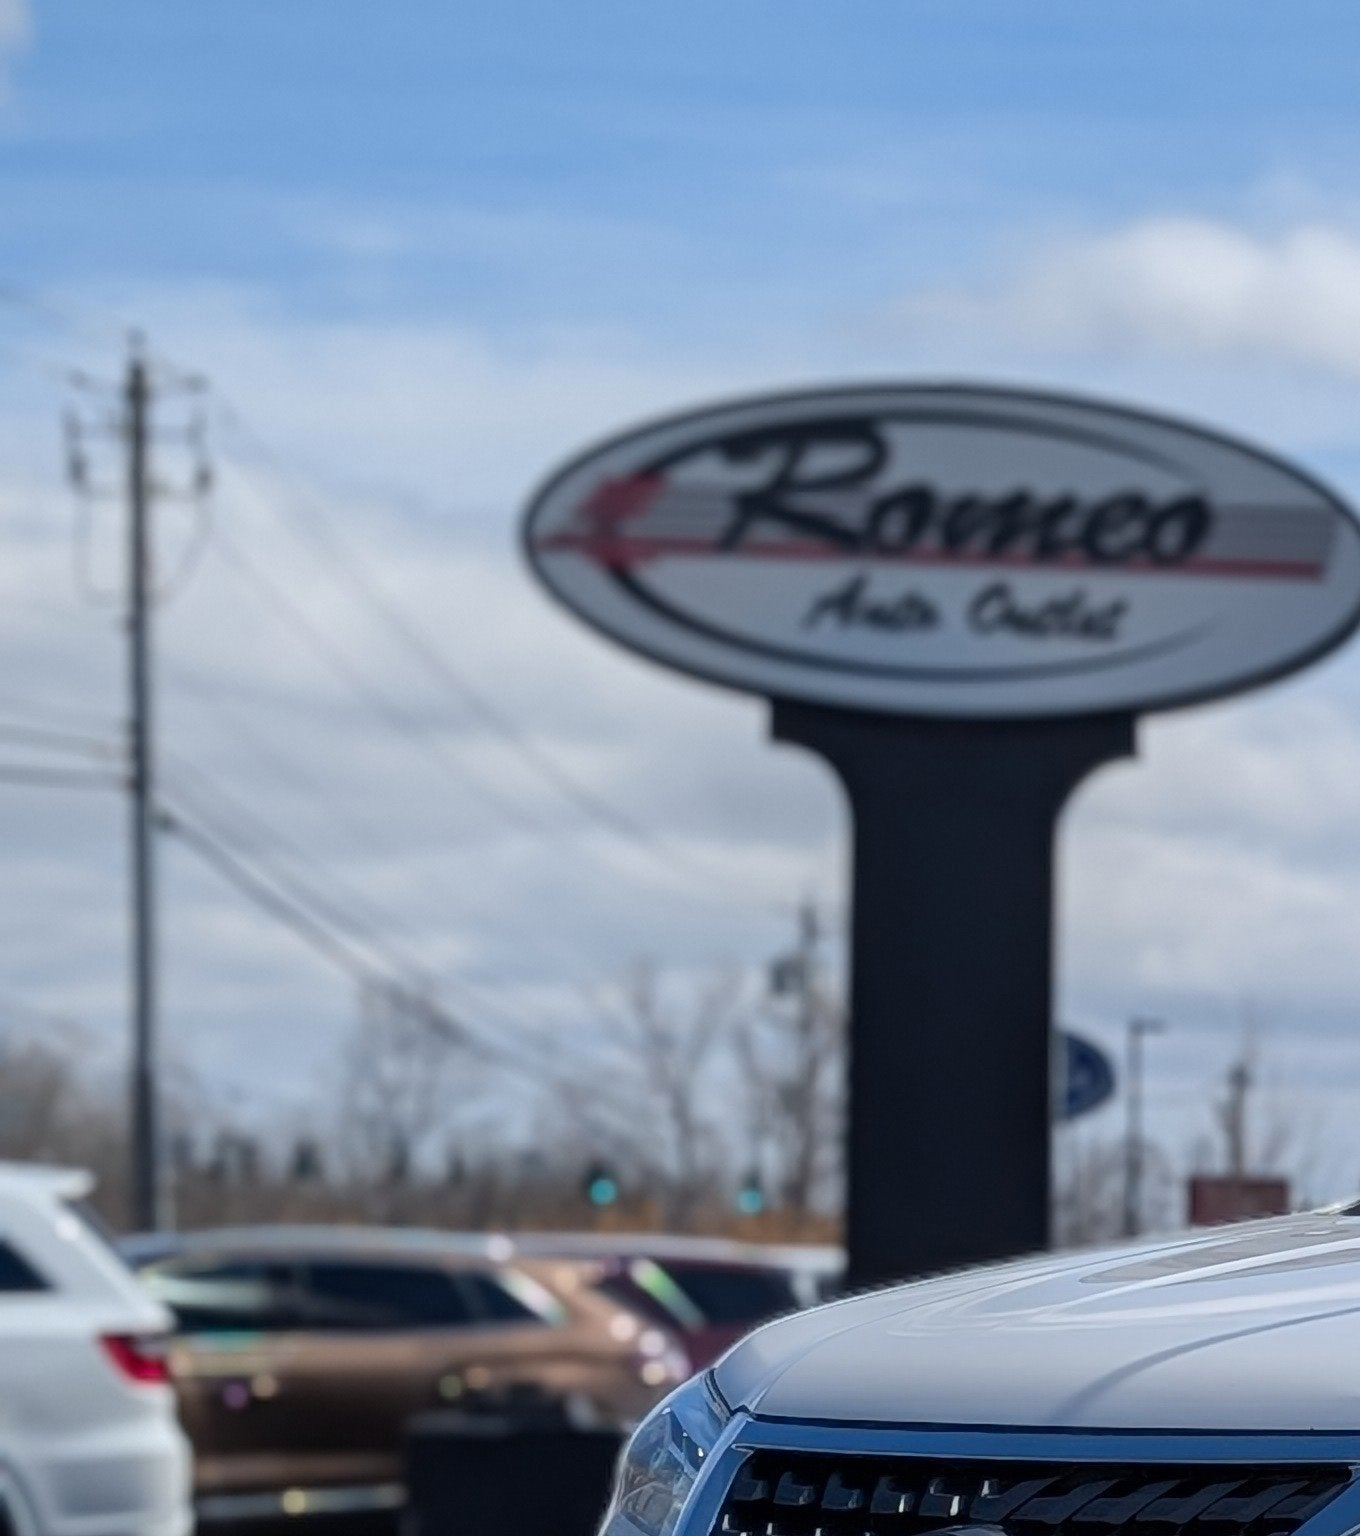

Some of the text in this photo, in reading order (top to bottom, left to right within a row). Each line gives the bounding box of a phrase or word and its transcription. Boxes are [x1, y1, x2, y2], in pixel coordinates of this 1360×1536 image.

[715, 416, 1213, 562] Romeo
[802, 572, 1130, 640] Auto Outlet
